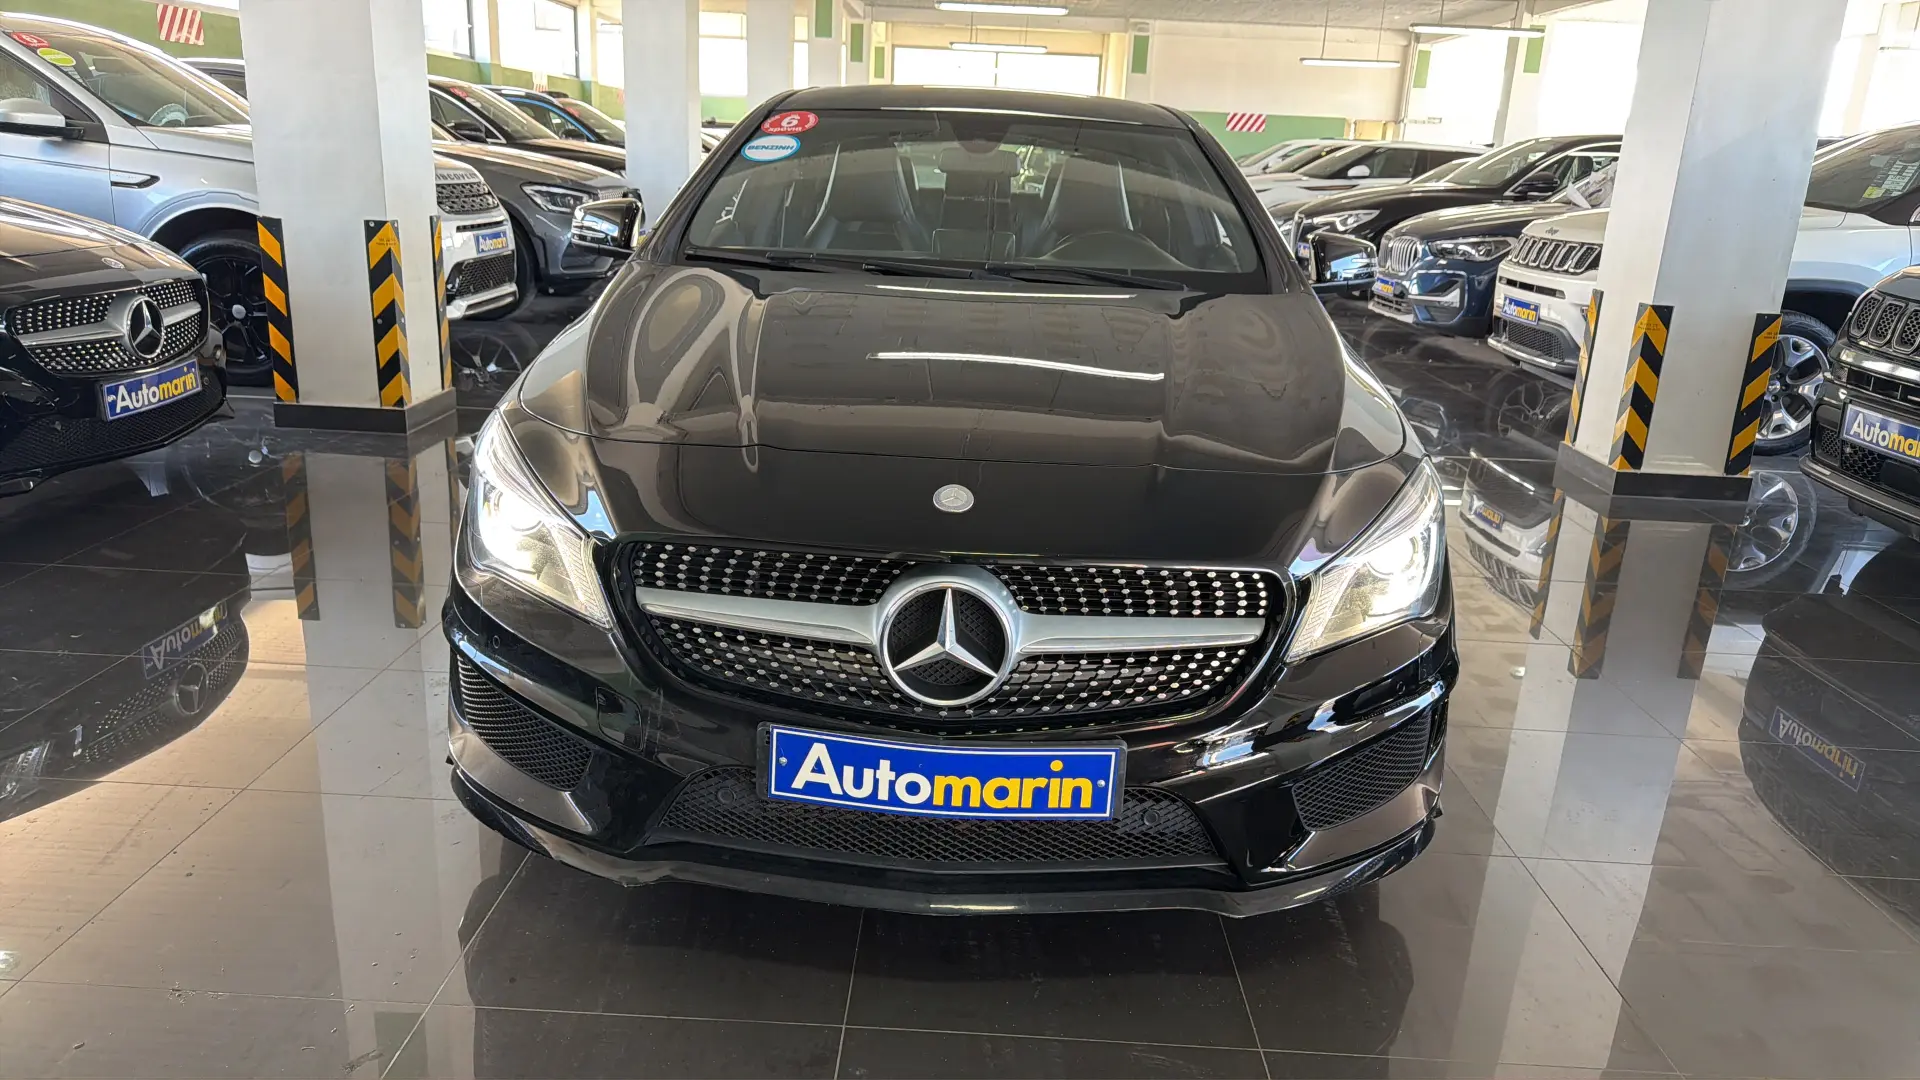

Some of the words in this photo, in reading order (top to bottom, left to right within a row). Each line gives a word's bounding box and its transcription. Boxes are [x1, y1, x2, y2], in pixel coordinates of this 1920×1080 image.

[780, 115, 801, 127] 6
[115, 366, 197, 414] Automarin
[790, 742, 1093, 808] Automarin
